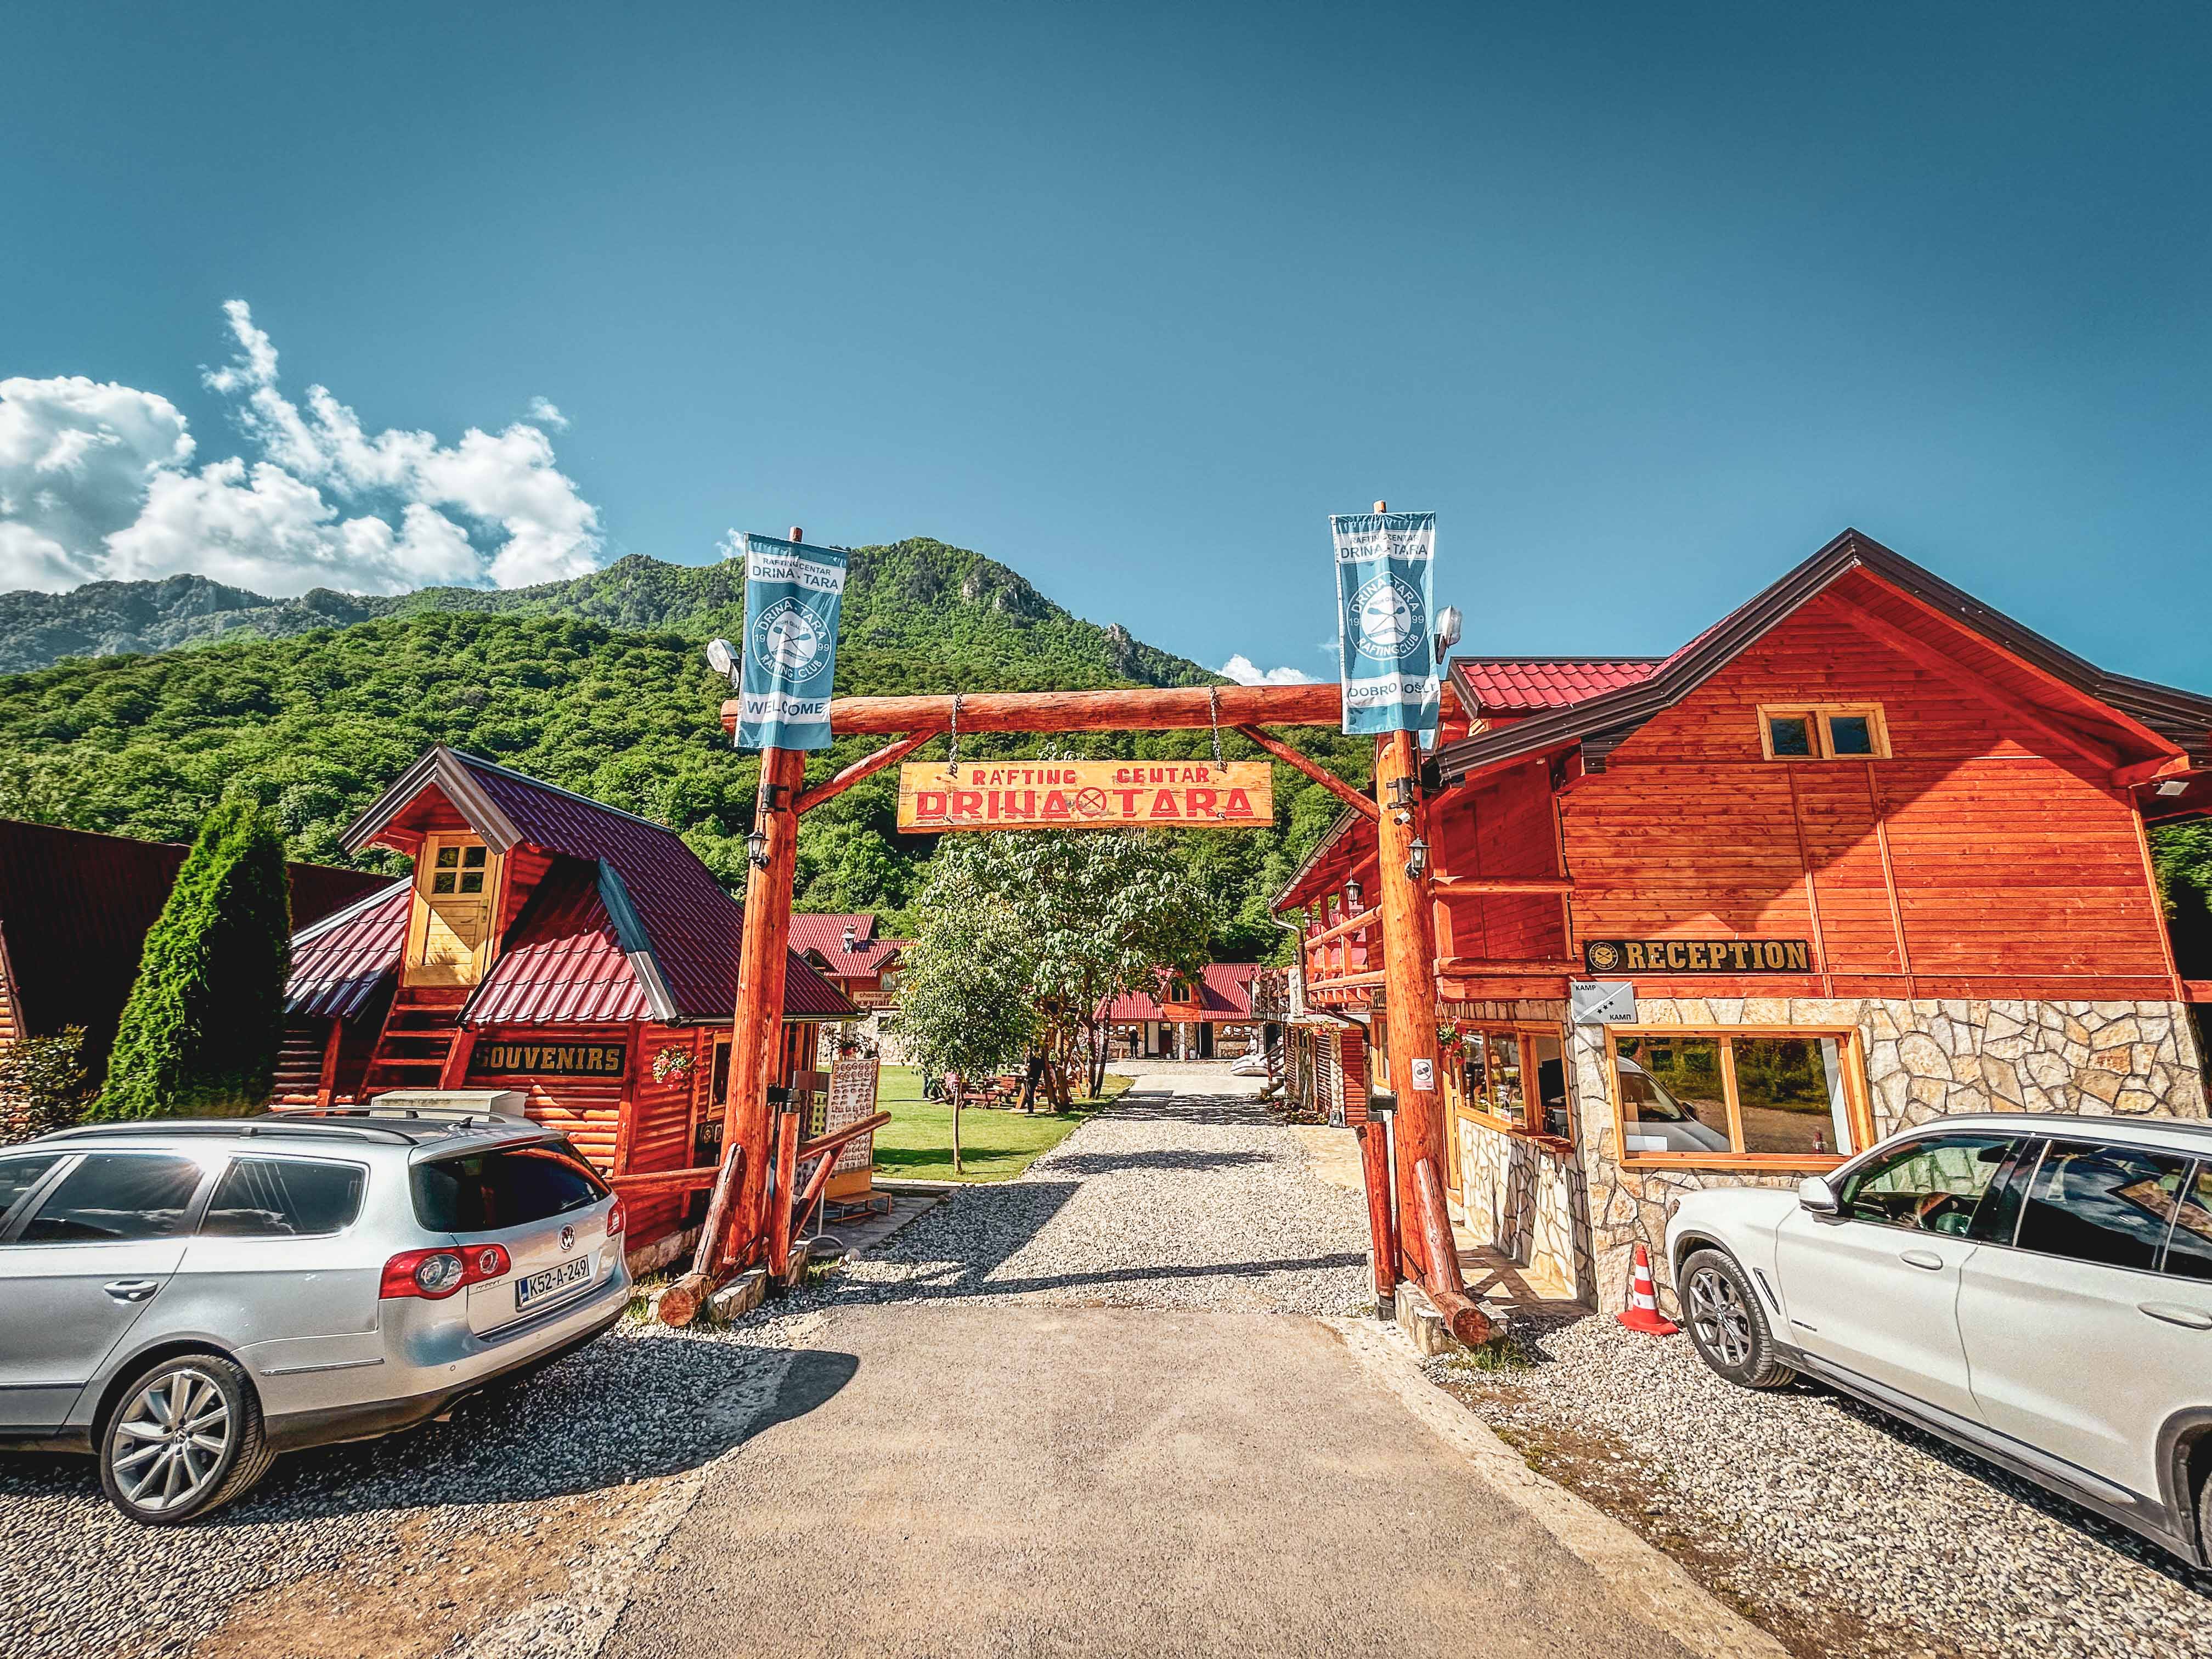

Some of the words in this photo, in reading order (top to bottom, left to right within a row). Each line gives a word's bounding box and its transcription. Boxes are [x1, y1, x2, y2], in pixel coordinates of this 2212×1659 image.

[1341, 544, 1383, 558] DRINA
[1393, 543, 1427, 555] TARA
[763, 557, 798, 567] RAFTING
[799, 563, 831, 575] CENTAR
[752, 566, 795, 578] DRINA
[804, 573, 838, 589] TARA
[1351, 578, 1387, 613] DRINA
[1393, 579, 1420, 612] TARA
[757, 600, 793, 631] DRINA
[800, 606, 827, 640] TARA
[1412, 615, 1424, 624] 99
[755, 634, 766, 642] 19
[1357, 637, 1400, 657] RAFTING
[1400, 634, 1419, 654] CLUB
[817, 643, 830, 652] 99
[798, 660, 822, 678] CLUB
[1350, 682, 1397, 697] DOBRO
[747, 699, 826, 716] WELCOME
[972, 769, 1076, 785] RAFTING
[1116, 767, 1210, 783] CENTAR
[916, 790, 1071, 820] DRINA
[1112, 787, 1254, 817] TARA
[1624, 941, 1808, 969] RECEPTION
[529, 1259, 586, 1296] K52-A-249
